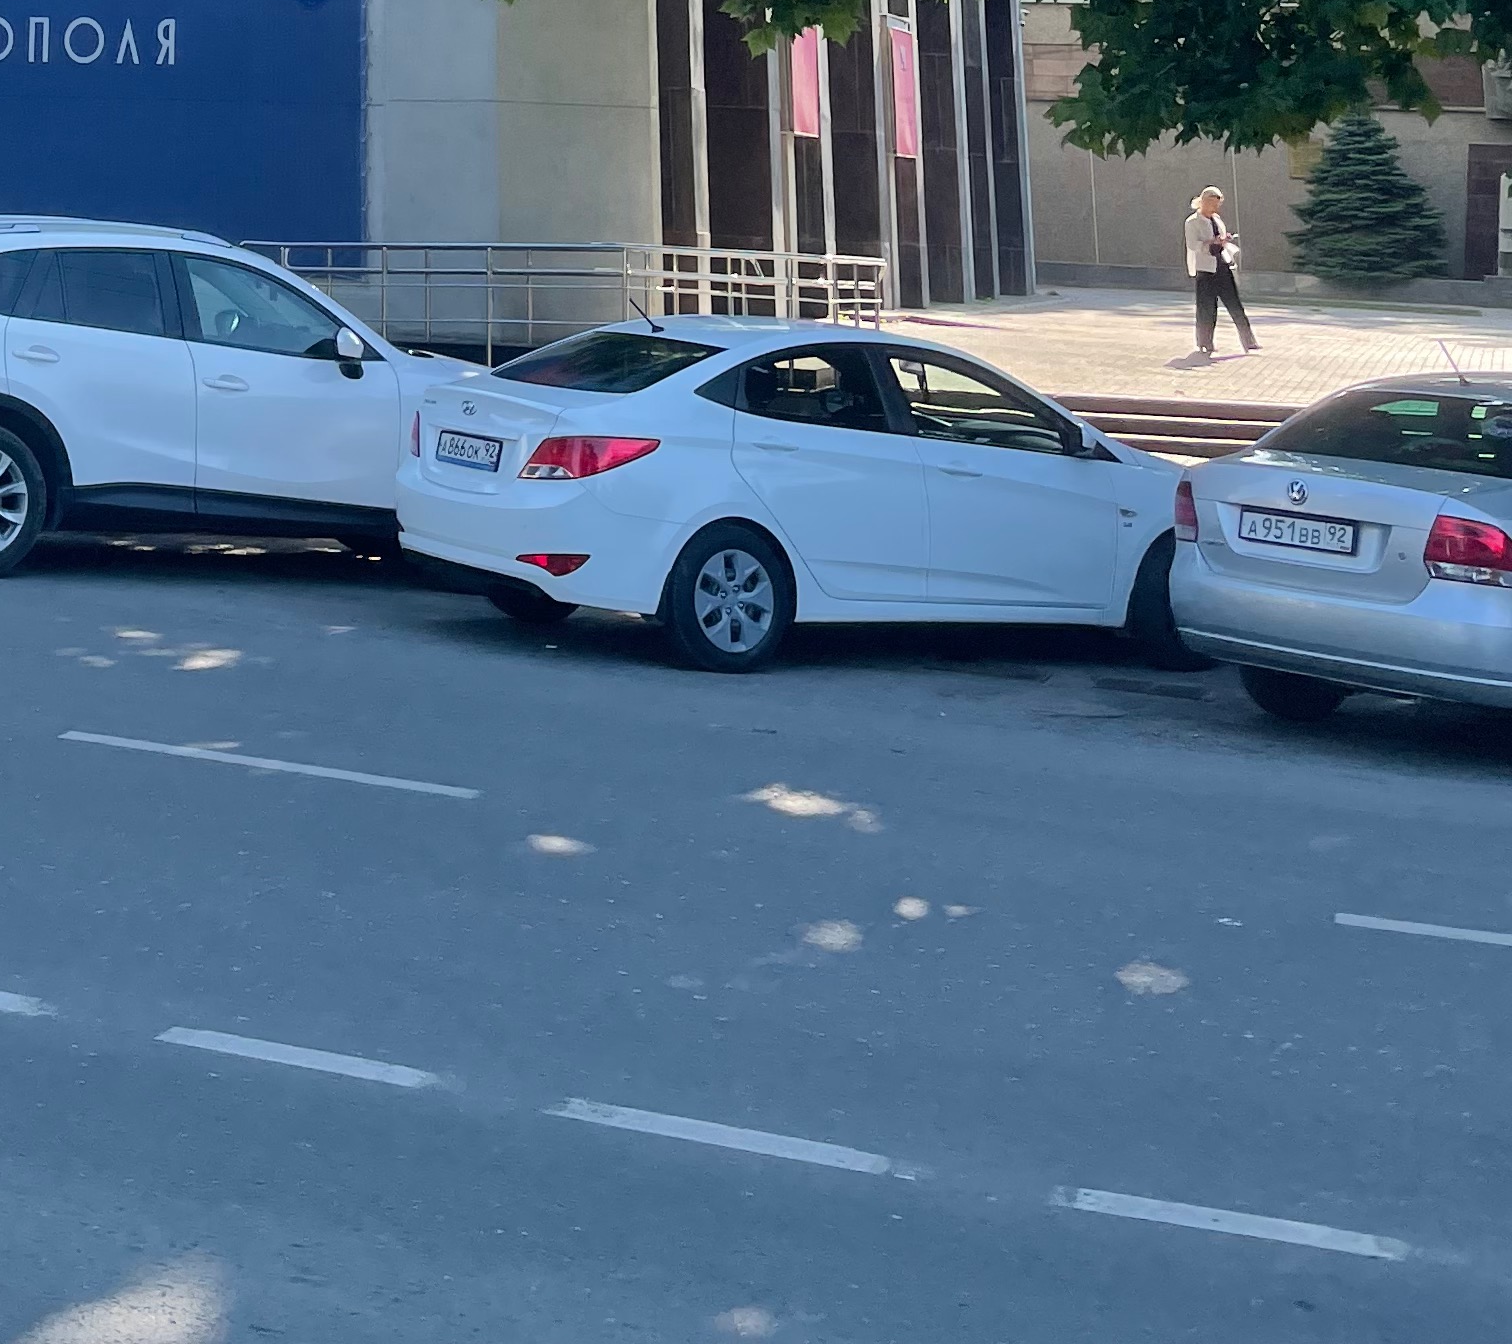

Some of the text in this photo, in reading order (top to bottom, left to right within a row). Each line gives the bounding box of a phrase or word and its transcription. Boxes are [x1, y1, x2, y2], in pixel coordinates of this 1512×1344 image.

[485, 442, 497, 458] 92
[1247, 517, 1347, 545] А951ВВ 92
